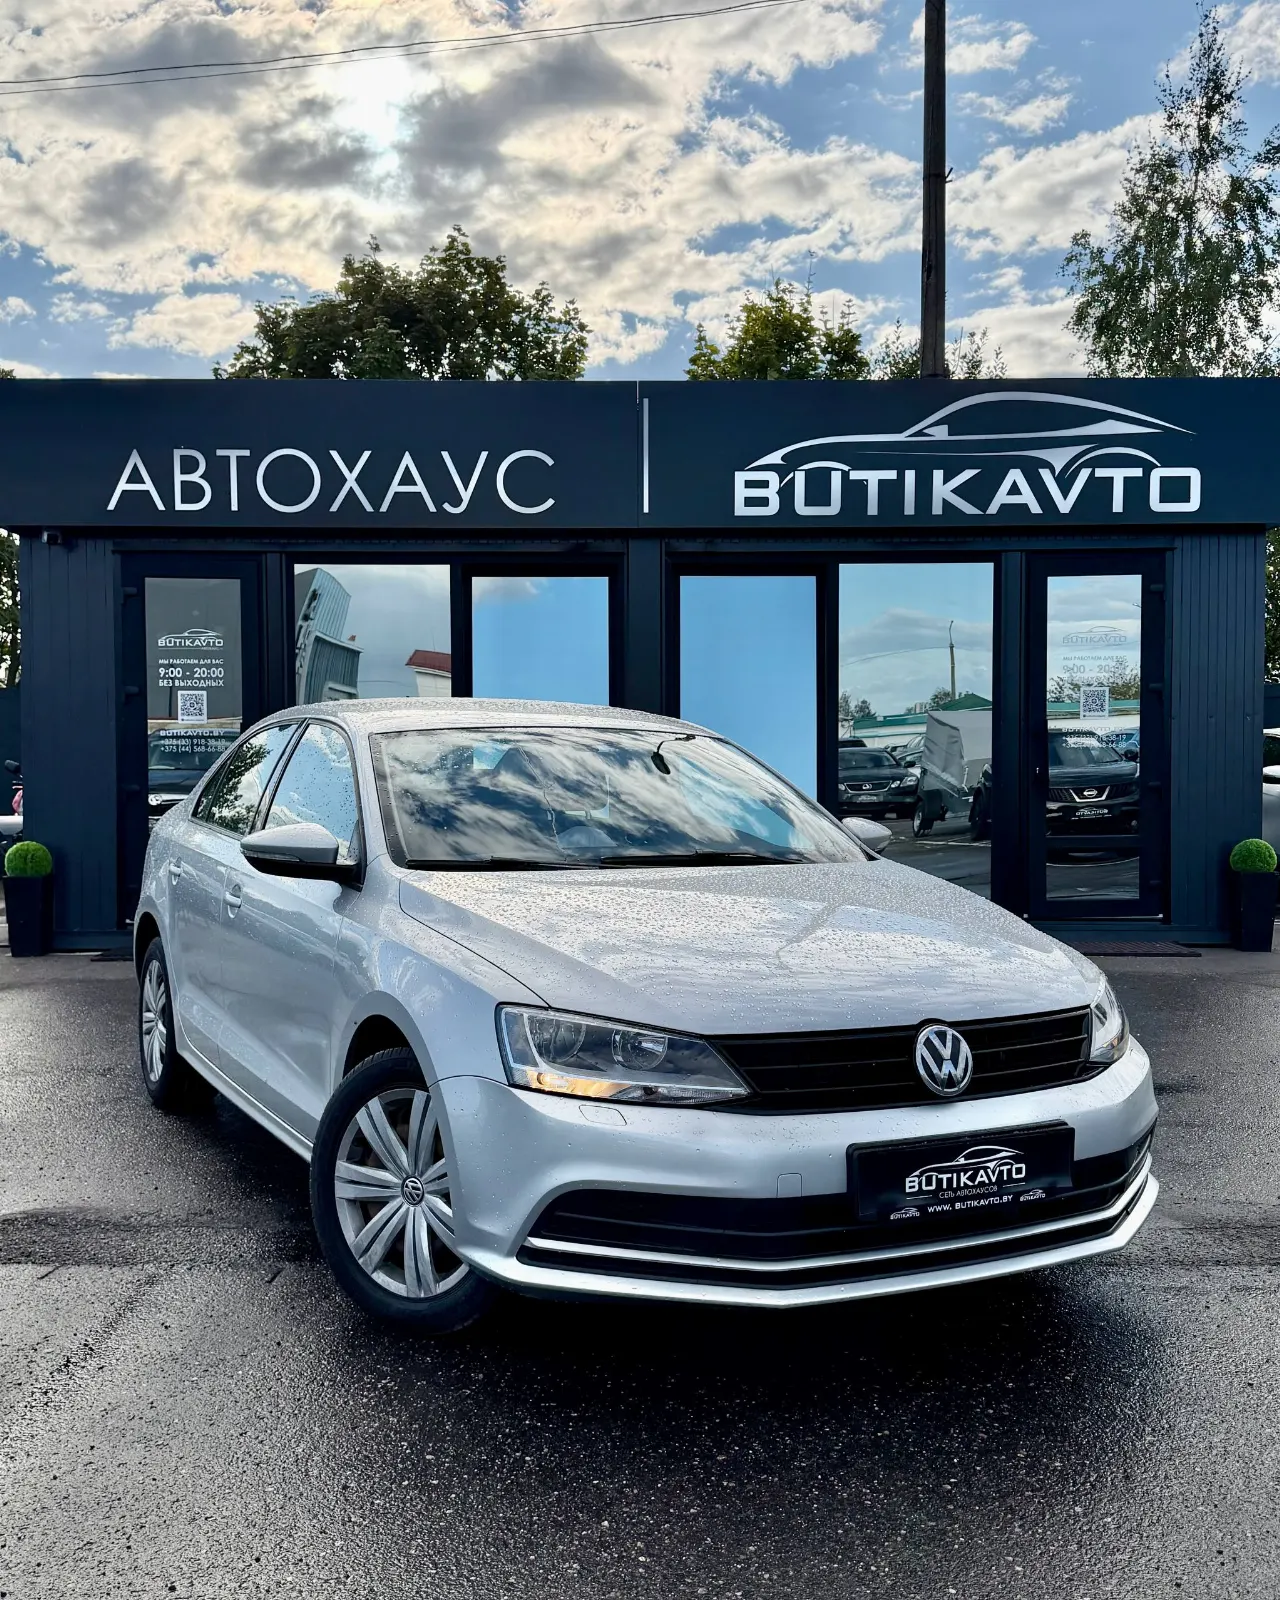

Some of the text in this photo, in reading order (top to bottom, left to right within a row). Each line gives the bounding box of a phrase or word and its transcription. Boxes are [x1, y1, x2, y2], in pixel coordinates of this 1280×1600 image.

[107, 447, 556, 514] АВТОХАУС
[734, 466, 1200, 516] BUTIKAVTO
[158, 638, 224, 647] BUTIKAVTO
[159, 668, 182, 677] 9:00
[193, 668, 224, 677] 20:00
[174, 679, 224, 687] ВЫХОДНЫХ
[905, 1163, 1026, 1193] BUTIKAVTO
[939, 1185, 998, 1199] СЕТЬ АВТОХАУСОВ
[927, 1195, 1014, 1213] WWW. BUTIKAVTO.BY
